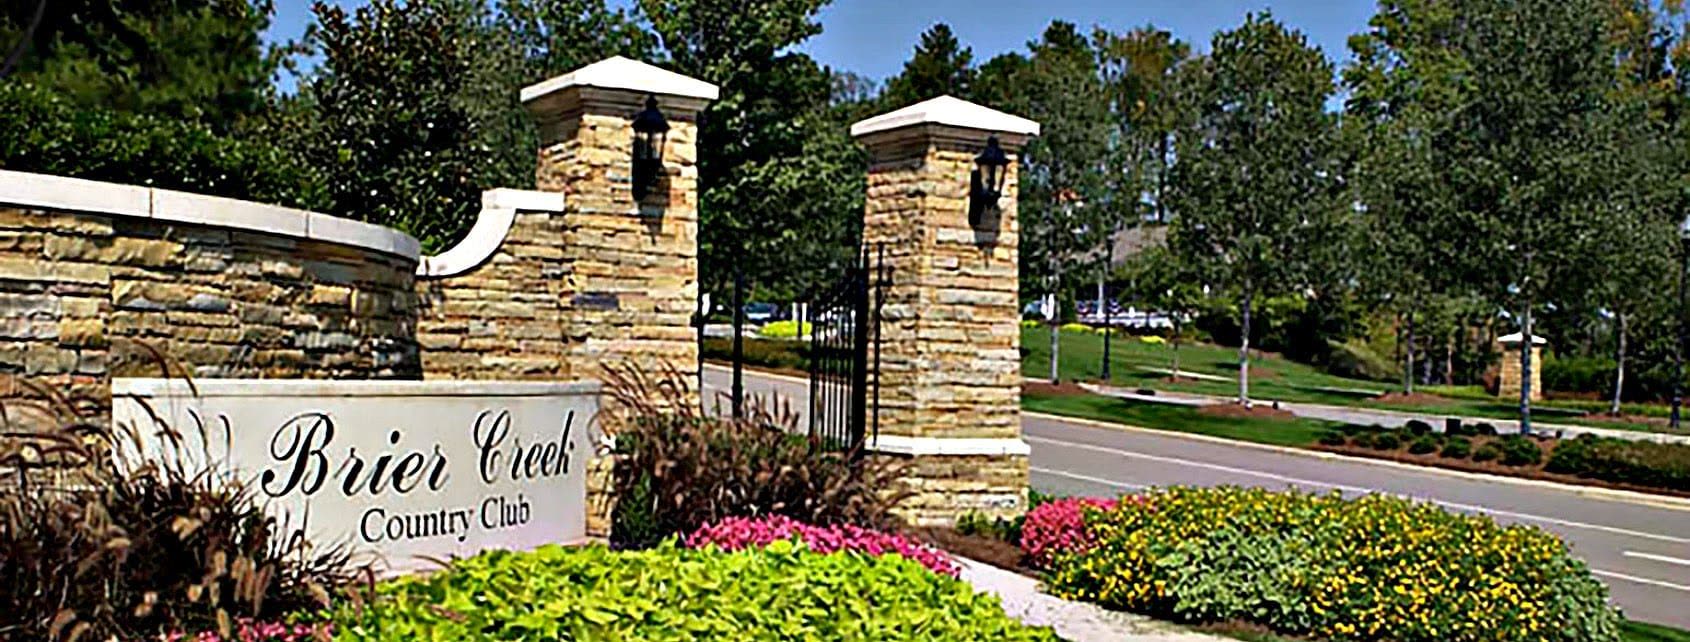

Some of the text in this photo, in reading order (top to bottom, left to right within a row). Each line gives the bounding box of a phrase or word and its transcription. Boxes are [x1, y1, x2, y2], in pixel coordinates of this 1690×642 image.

[262, 409, 575, 497] Brier Creek
[360, 494, 531, 542] Country Club
